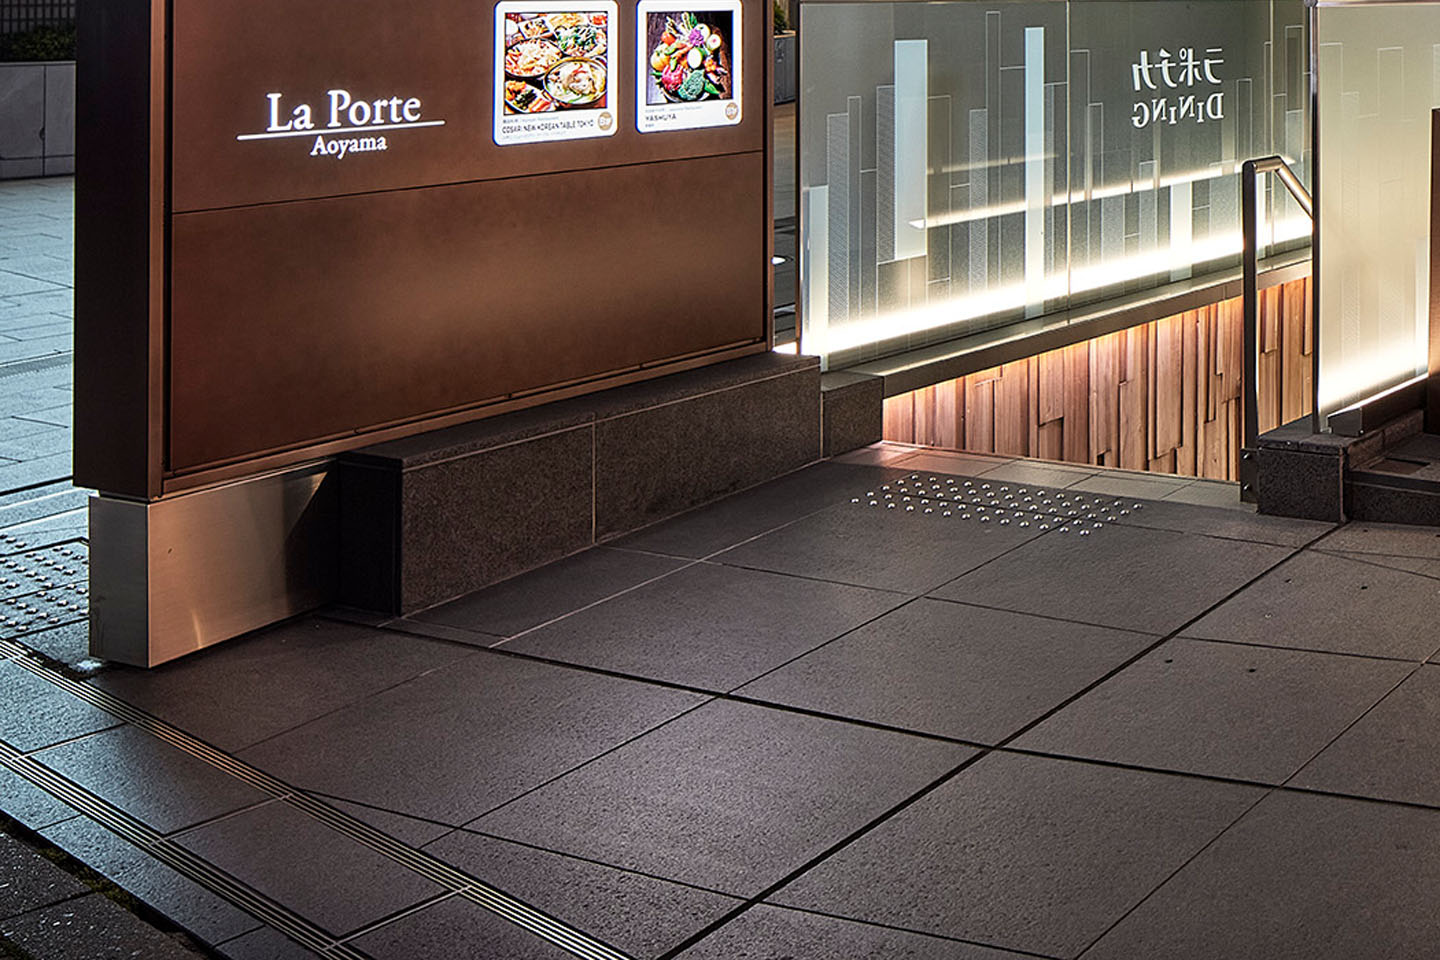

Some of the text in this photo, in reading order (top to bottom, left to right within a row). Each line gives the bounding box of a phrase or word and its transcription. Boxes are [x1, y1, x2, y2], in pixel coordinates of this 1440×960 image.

[266, 89, 422, 132] La Porte
[310, 135, 388, 160] Aoyama
